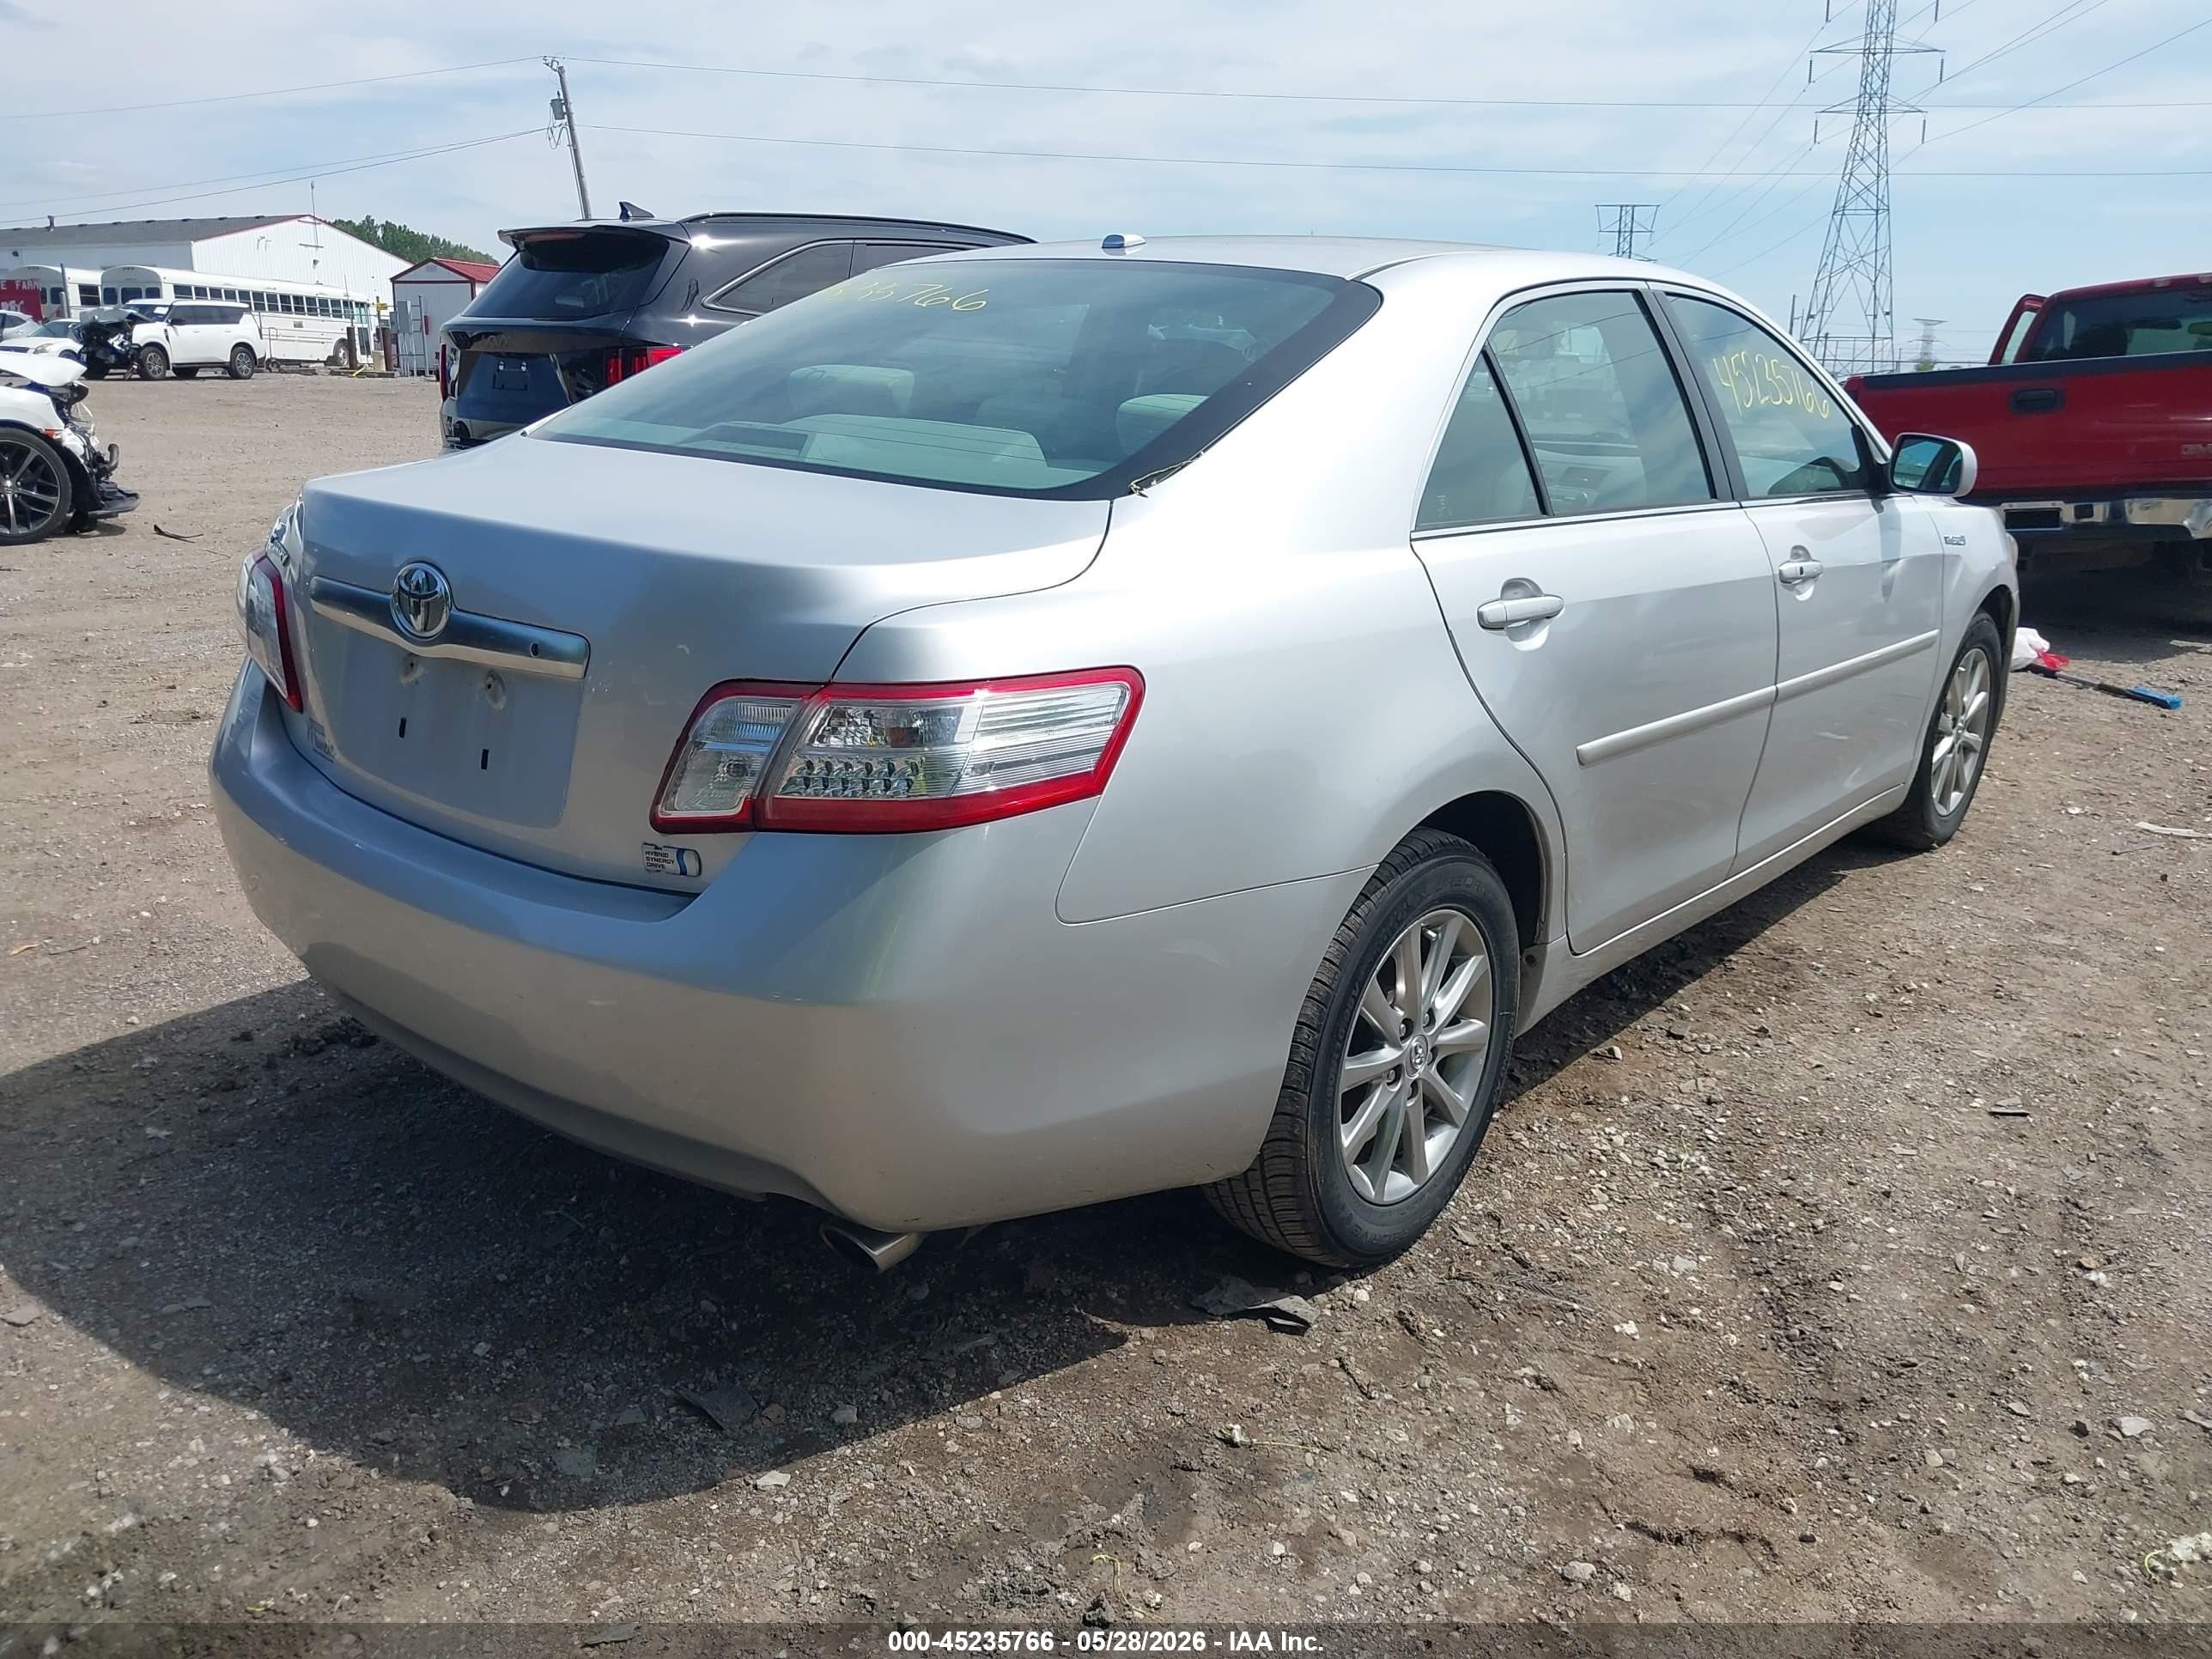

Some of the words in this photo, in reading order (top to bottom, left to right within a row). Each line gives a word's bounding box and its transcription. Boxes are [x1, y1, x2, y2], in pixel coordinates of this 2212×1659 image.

[1712, 350, 1830, 419] 45235766
[645, 850, 669, 859] HYBRID
[645, 856, 675, 866] SYNERGY
